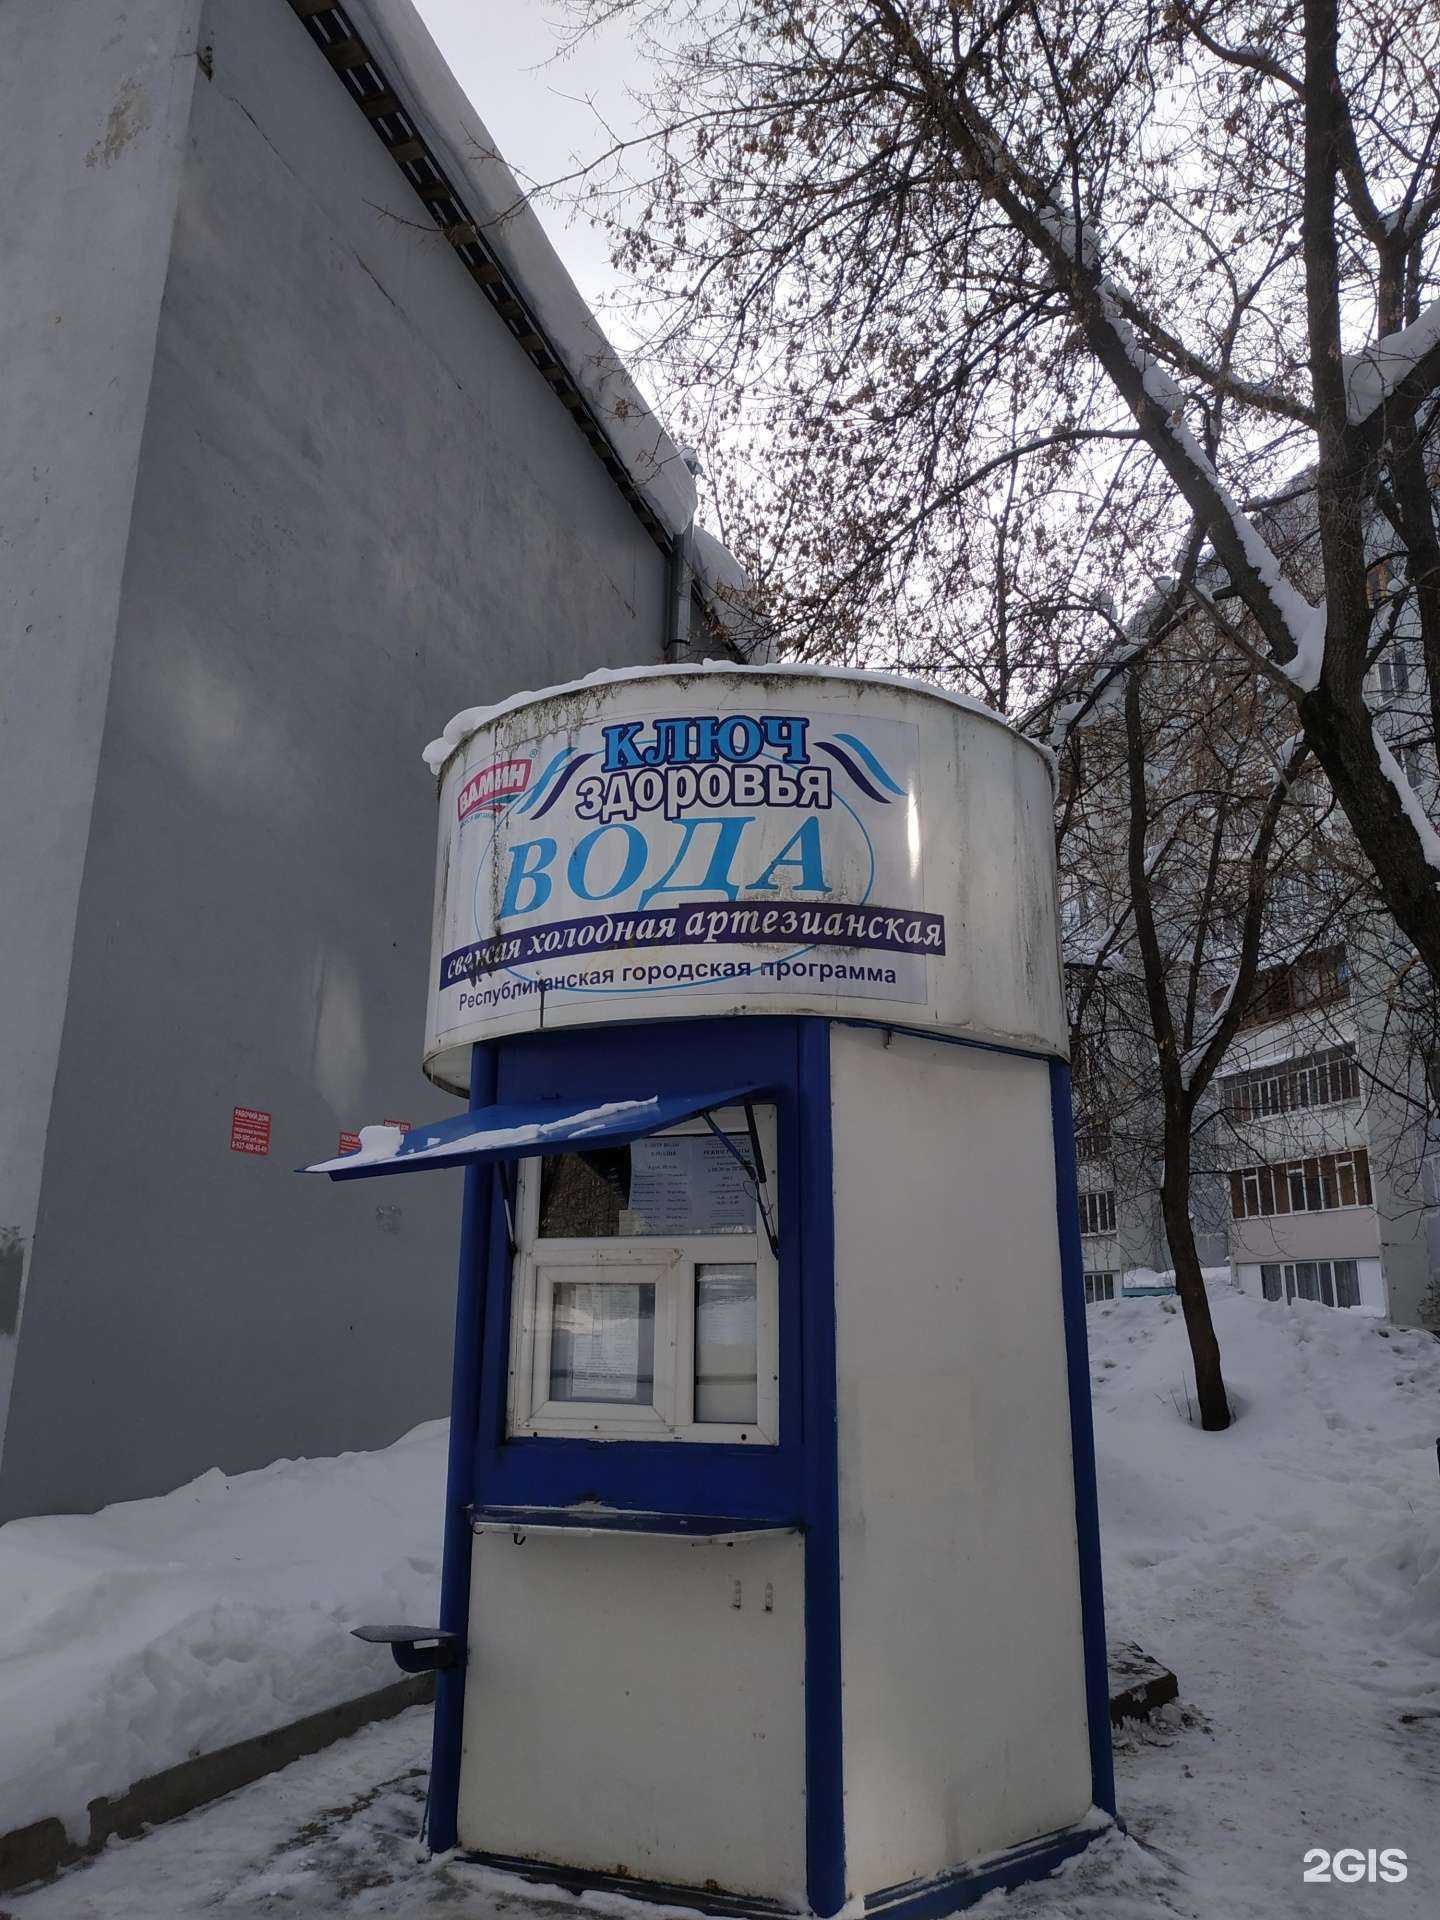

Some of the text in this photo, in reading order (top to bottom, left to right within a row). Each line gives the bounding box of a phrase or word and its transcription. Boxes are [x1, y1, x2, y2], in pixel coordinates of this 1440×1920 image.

[601, 715, 810, 773] КЛЮЧ
[459, 763, 527, 818] ВАМИН
[498, 815, 833, 919] ВОДА
[447, 909, 943, 980] свежая холодная артезианская
[459, 961, 897, 1011] Республиканская городская программа
